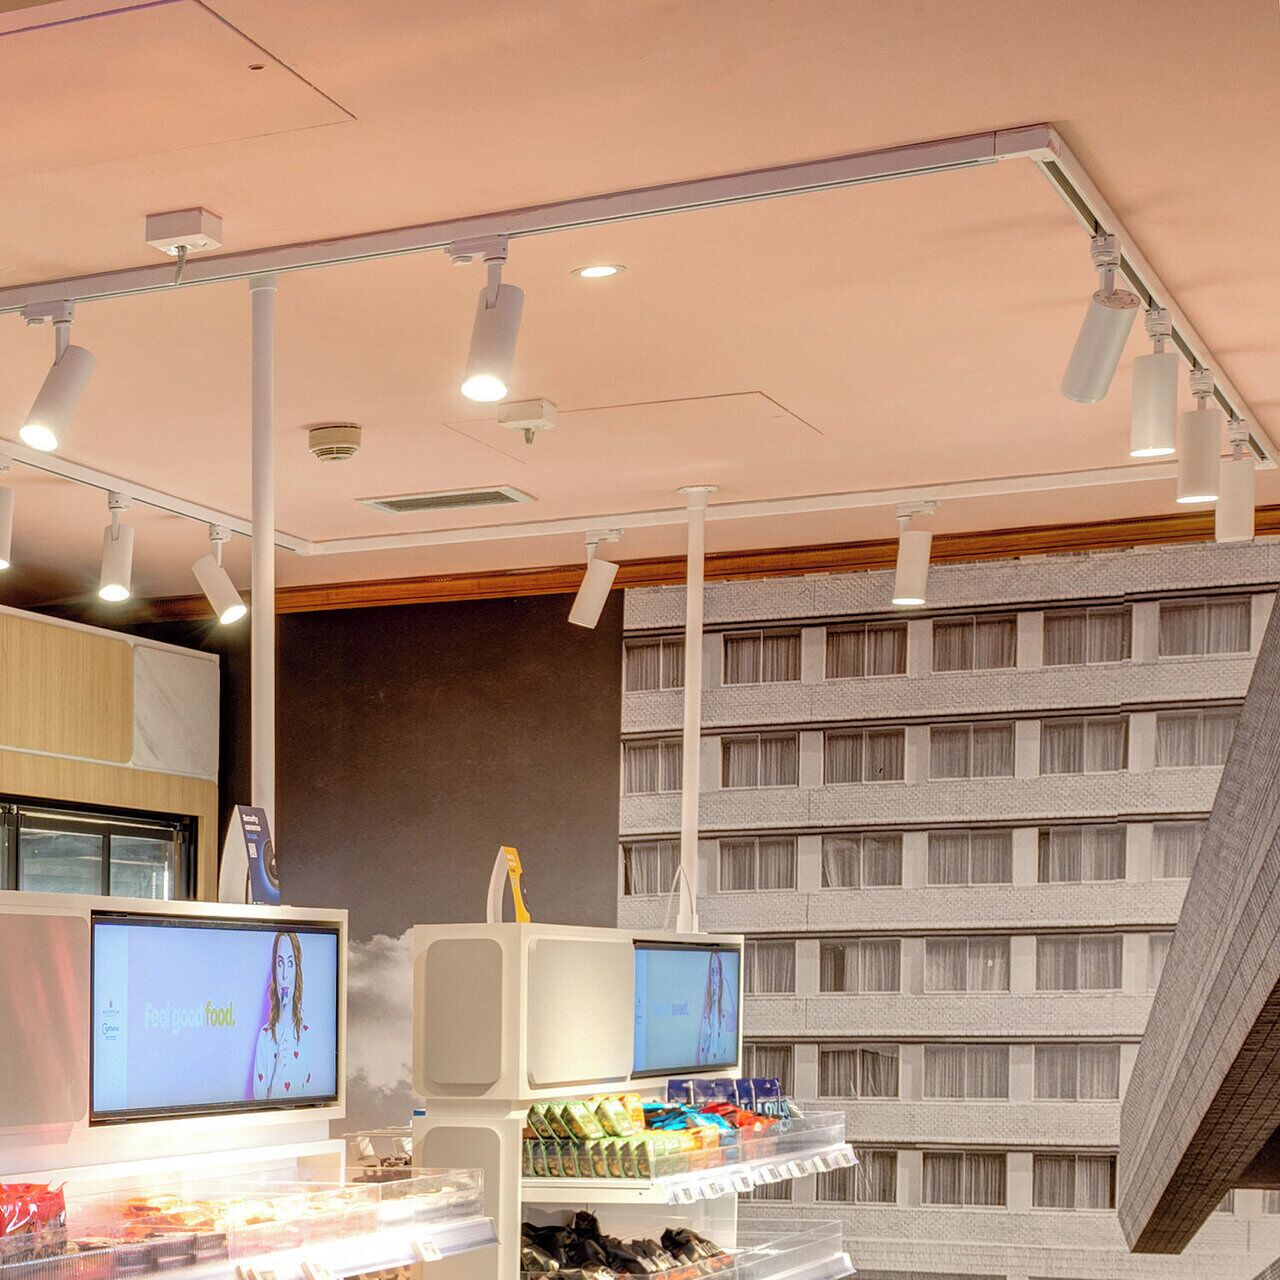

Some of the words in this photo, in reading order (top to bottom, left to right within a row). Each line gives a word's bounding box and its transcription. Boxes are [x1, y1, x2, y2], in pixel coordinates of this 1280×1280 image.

[144, 1002, 170, 1028] Feel
[171, 1002, 204, 1034] good
[205, 1000, 236, 1026] food.
